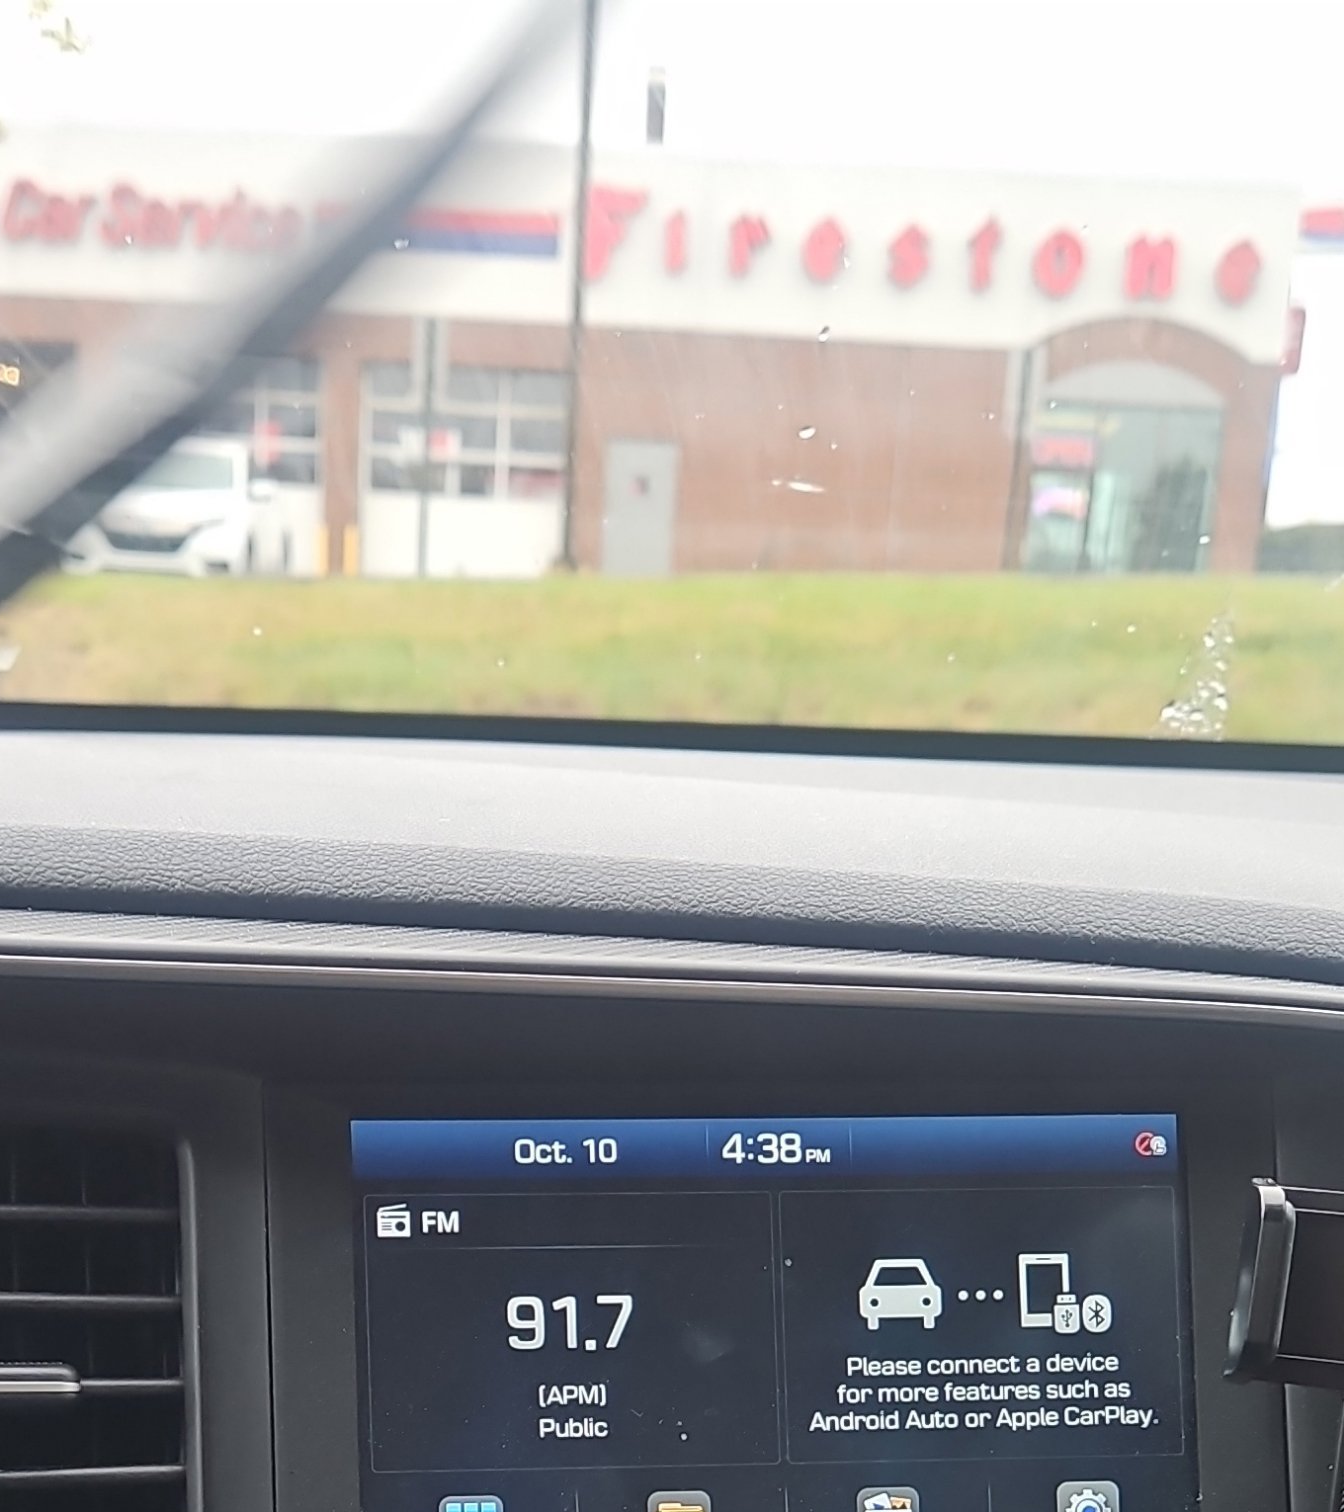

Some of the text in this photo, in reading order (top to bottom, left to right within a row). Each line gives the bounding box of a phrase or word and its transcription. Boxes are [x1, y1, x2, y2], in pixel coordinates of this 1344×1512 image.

[583, 184, 1260, 304] Firestone
[514, 1138, 618, 1164] Oct. 10
[421, 1210, 460, 1234] FM
[506, 1294, 633, 1351] 91.7
[846, 1352, 1119, 1377] Please connect a device
[538, 1383, 607, 1408] (APM)
[836, 1378, 1132, 1404] for more features such as
[539, 1417, 609, 1438] Public
[809, 1405, 1159, 1432] Android Auto or Apple CarPlay.
